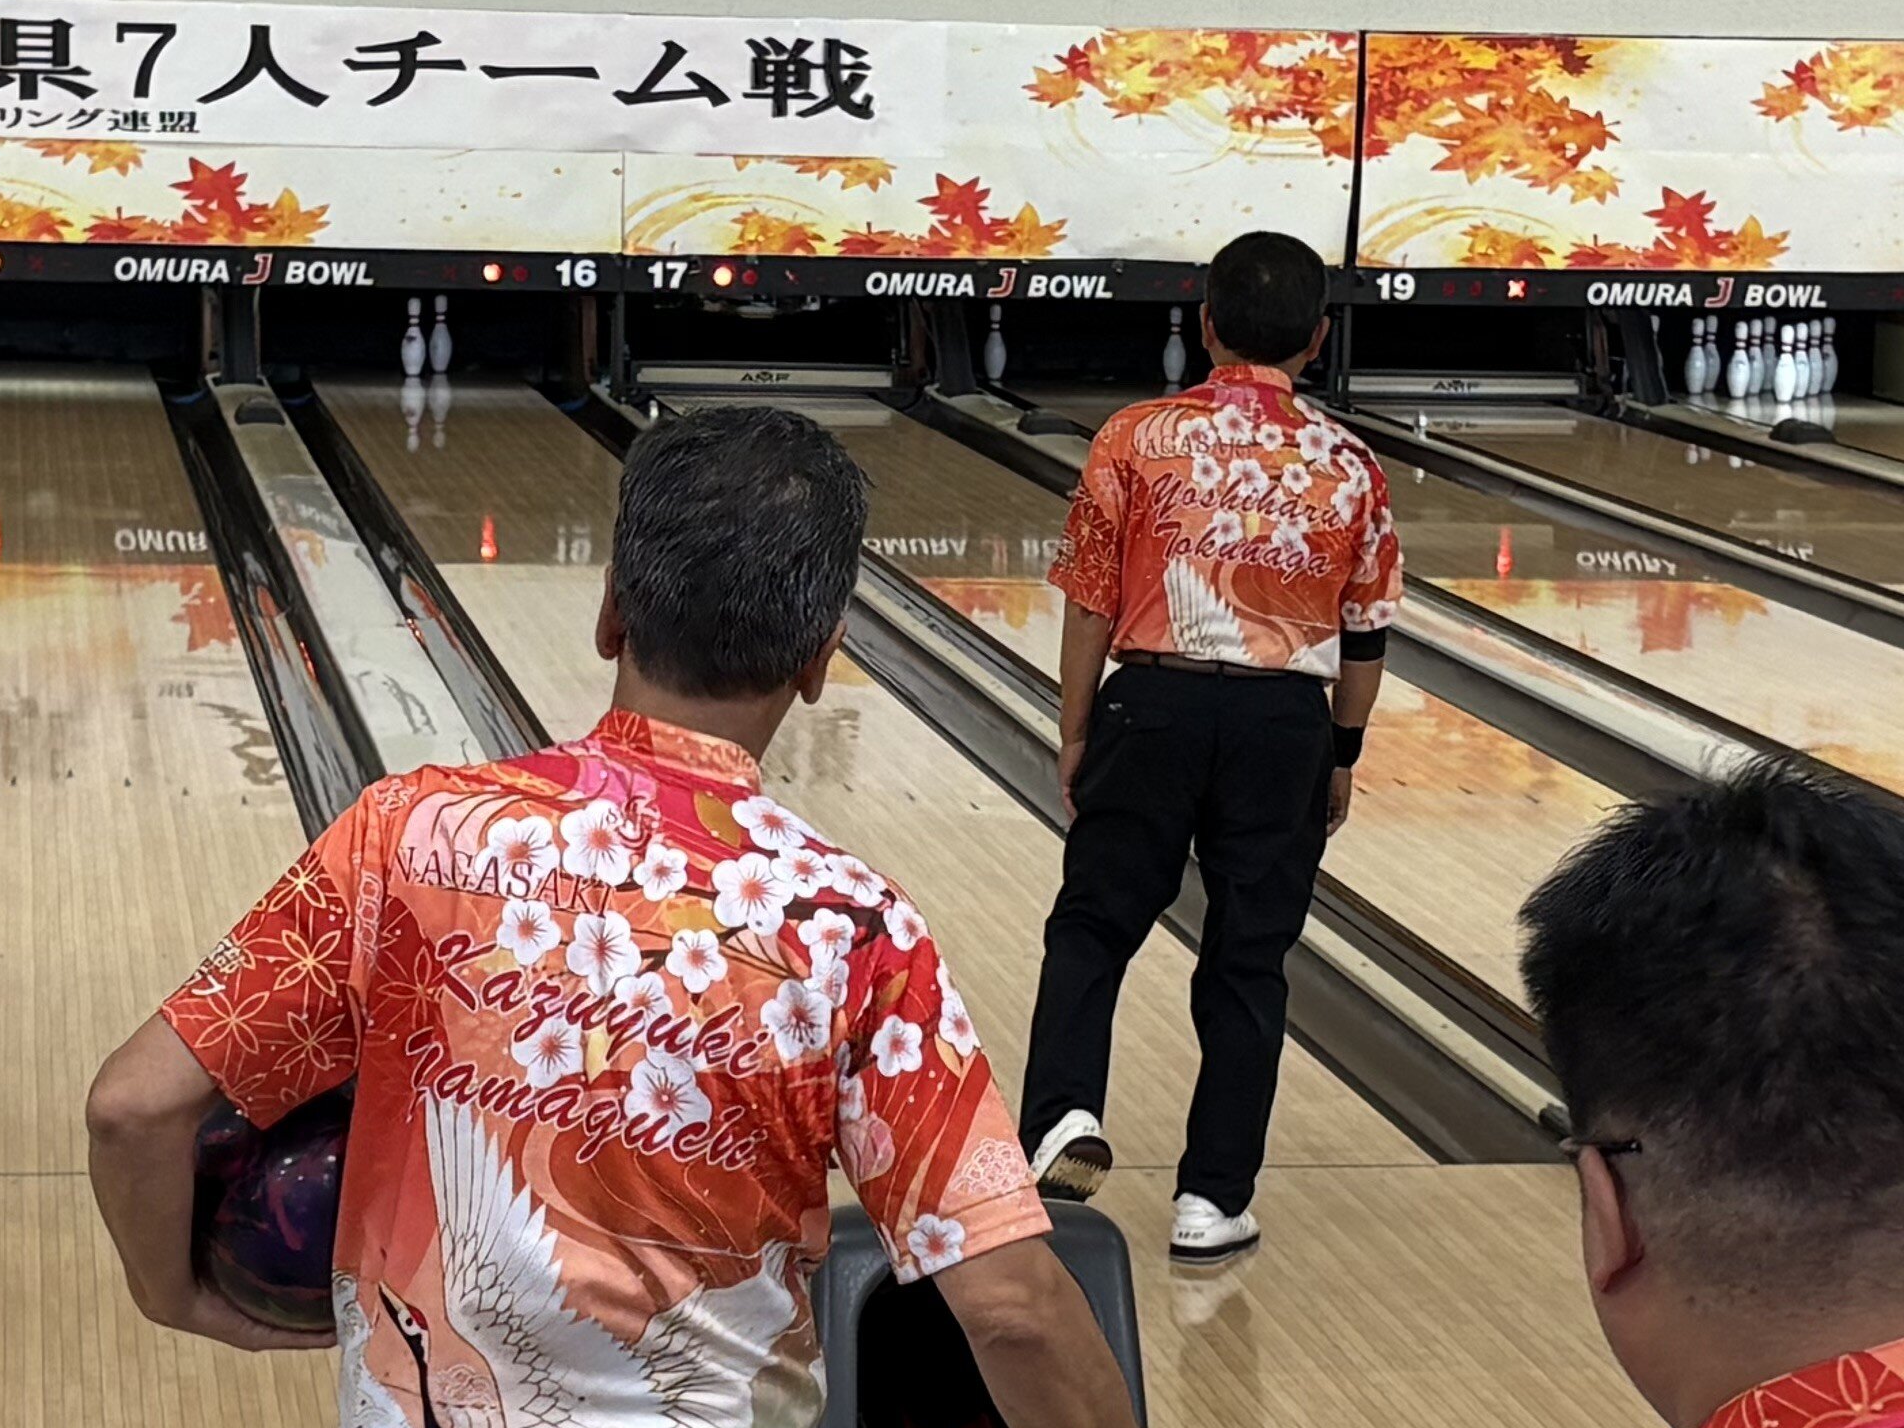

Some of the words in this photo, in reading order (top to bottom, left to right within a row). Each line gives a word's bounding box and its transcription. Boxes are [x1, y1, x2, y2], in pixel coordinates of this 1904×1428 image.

[113, 257, 232, 286] OMURA
[285, 261, 375, 288] BOWL
[555, 258, 598, 290] 16
[647, 262, 685, 291] 17
[865, 270, 976, 299] OMURA
[1027, 273, 1114, 301] BOWL
[1375, 272, 1417, 301] 19
[1586, 280, 1694, 307] OMURA
[1743, 283, 1828, 309] BOWL
[1150, 472, 1348, 532] Yoshiharu
[1151, 521, 1333, 585] Tokunaga
[395, 846, 616, 917] NAGASAKI
[436, 931, 770, 1079] Kazuyuki
